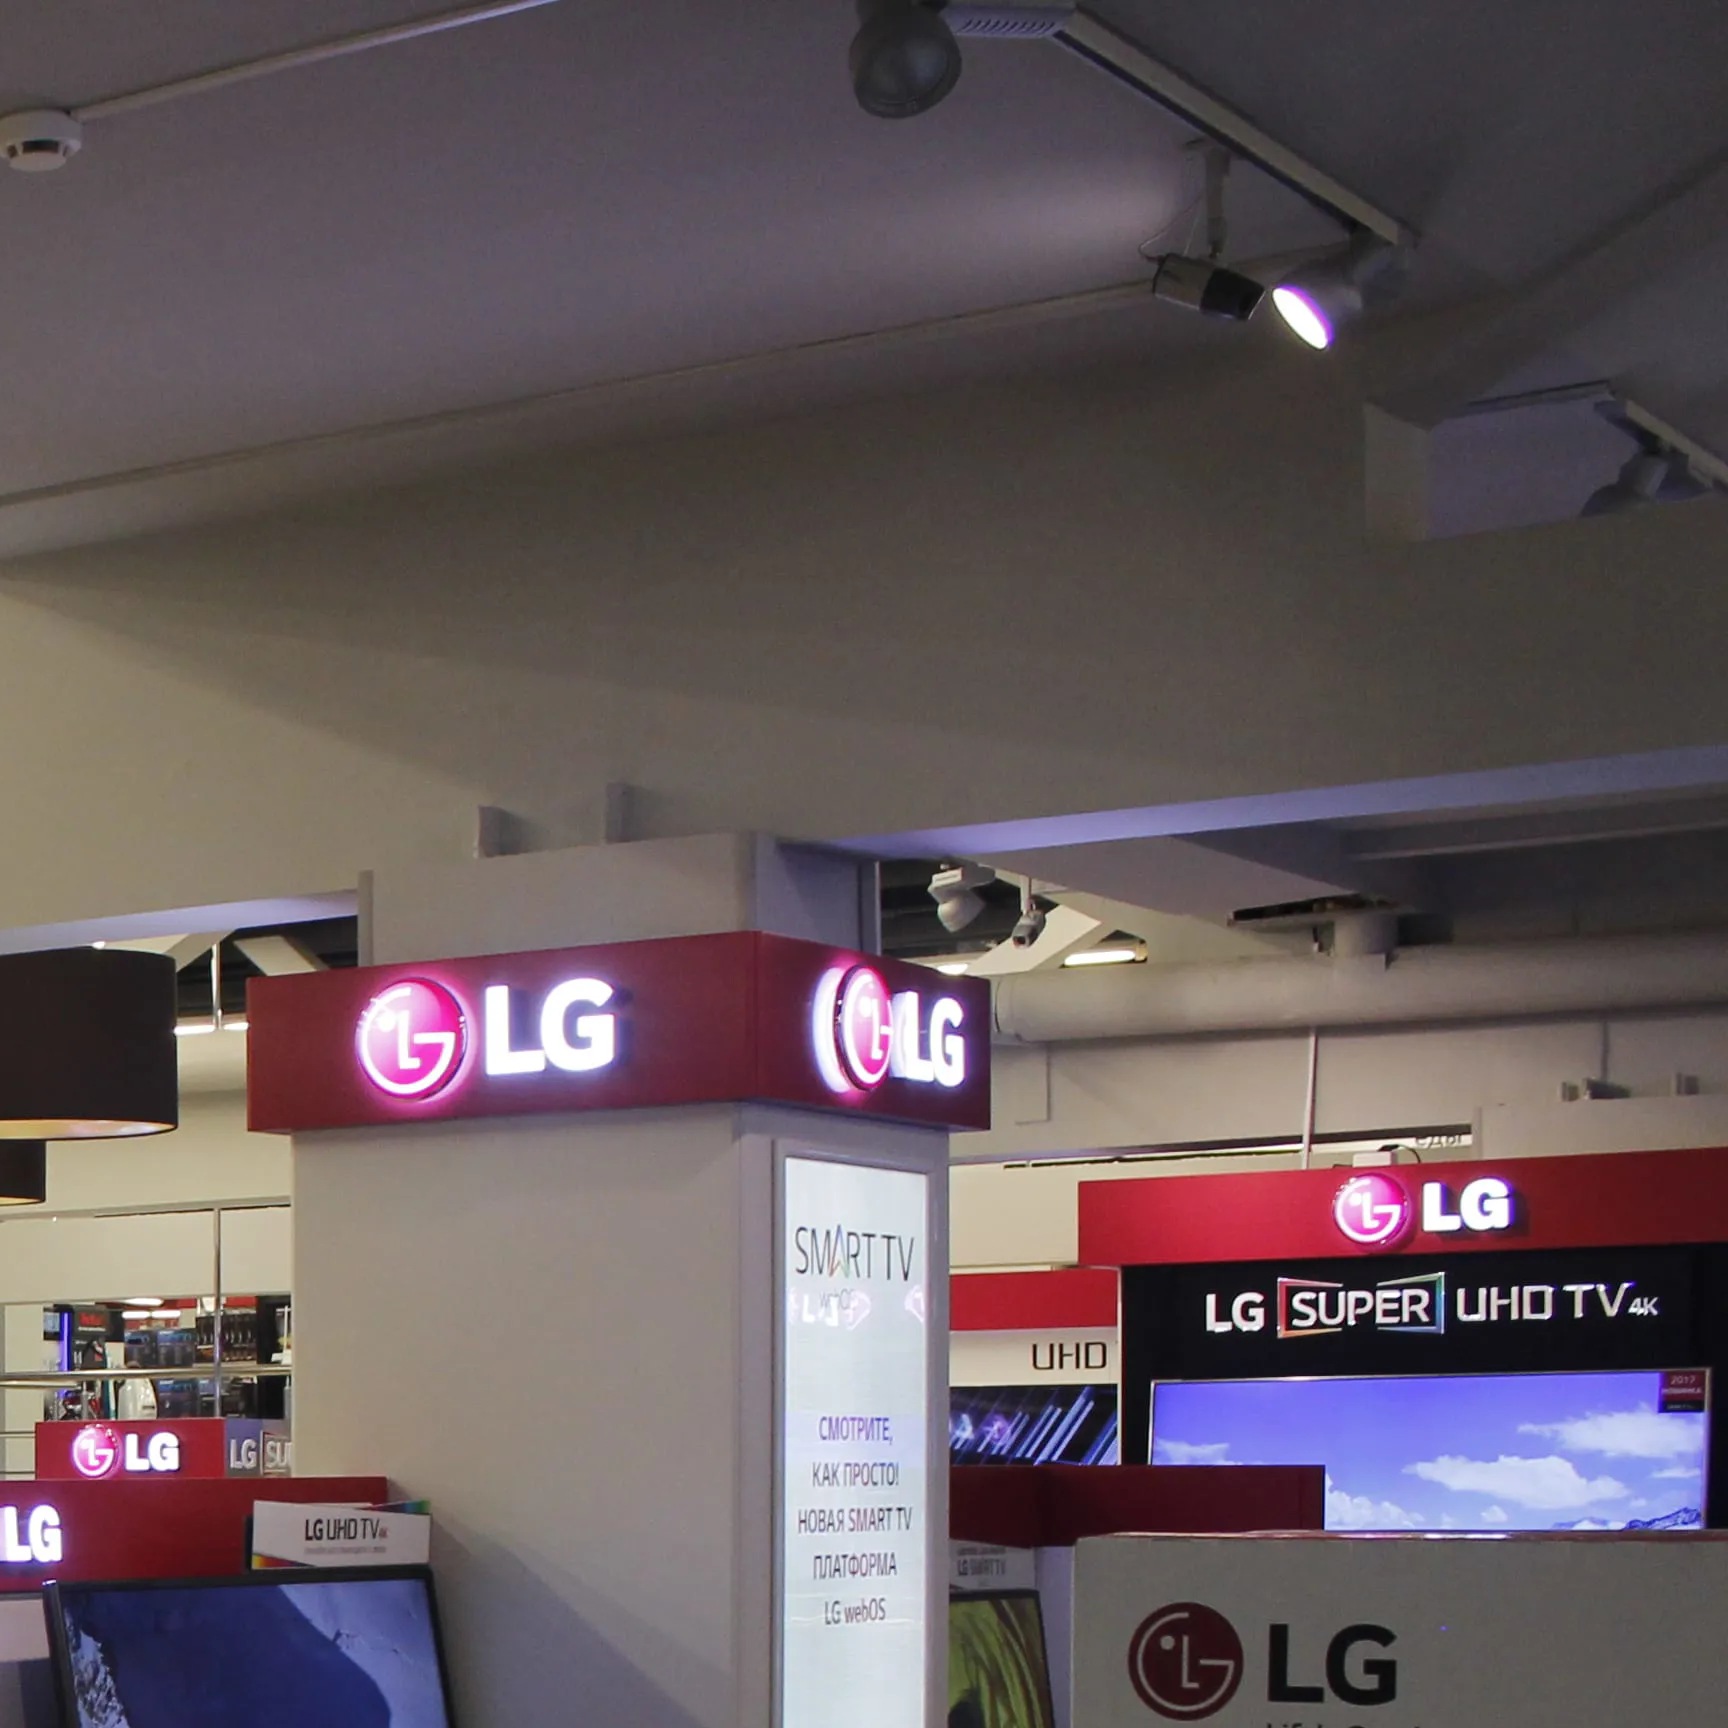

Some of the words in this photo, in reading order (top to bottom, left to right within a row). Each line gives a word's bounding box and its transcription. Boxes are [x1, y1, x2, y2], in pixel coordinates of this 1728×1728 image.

[485, 977, 616, 1075] LG
[896, 989, 966, 1087] LG
[1423, 1178, 1514, 1234] LG
[795, 1223, 877, 1280] SMART
[881, 1231, 914, 1282] TV
[1204, 1291, 1266, 1334] LG
[1292, 1287, 1432, 1327] SUPER
[1455, 1284, 1554, 1323] UHD
[1562, 1281, 1636, 1318] TV
[1628, 1295, 1660, 1316] 4K
[1031, 1341, 1108, 1372] UHD
[818, 1415, 894, 1444] СМОТРИТЕ,
[124, 1431, 180, 1472] LG
[229, 1438, 257, 1469] LG
[265, 1440, 292, 1469] SU
[811, 1462, 841, 1487] КАК
[843, 1461, 900, 1488] ПРОСТО!
[2, 1502, 63, 1563] LG
[304, 1518, 324, 1541] LG
[326, 1518, 358, 1540] UHD
[361, 1518, 380, 1540] TV
[798, 1508, 845, 1535] НОВАЯ
[848, 1507, 894, 1533] SMART
[895, 1507, 913, 1532] TV
[812, 1552, 898, 1580] ПЛАТФОРМА
[824, 1599, 842, 1626] LG
[843, 1597, 887, 1625] webOS
[1266, 1623, 1398, 1706] LG
